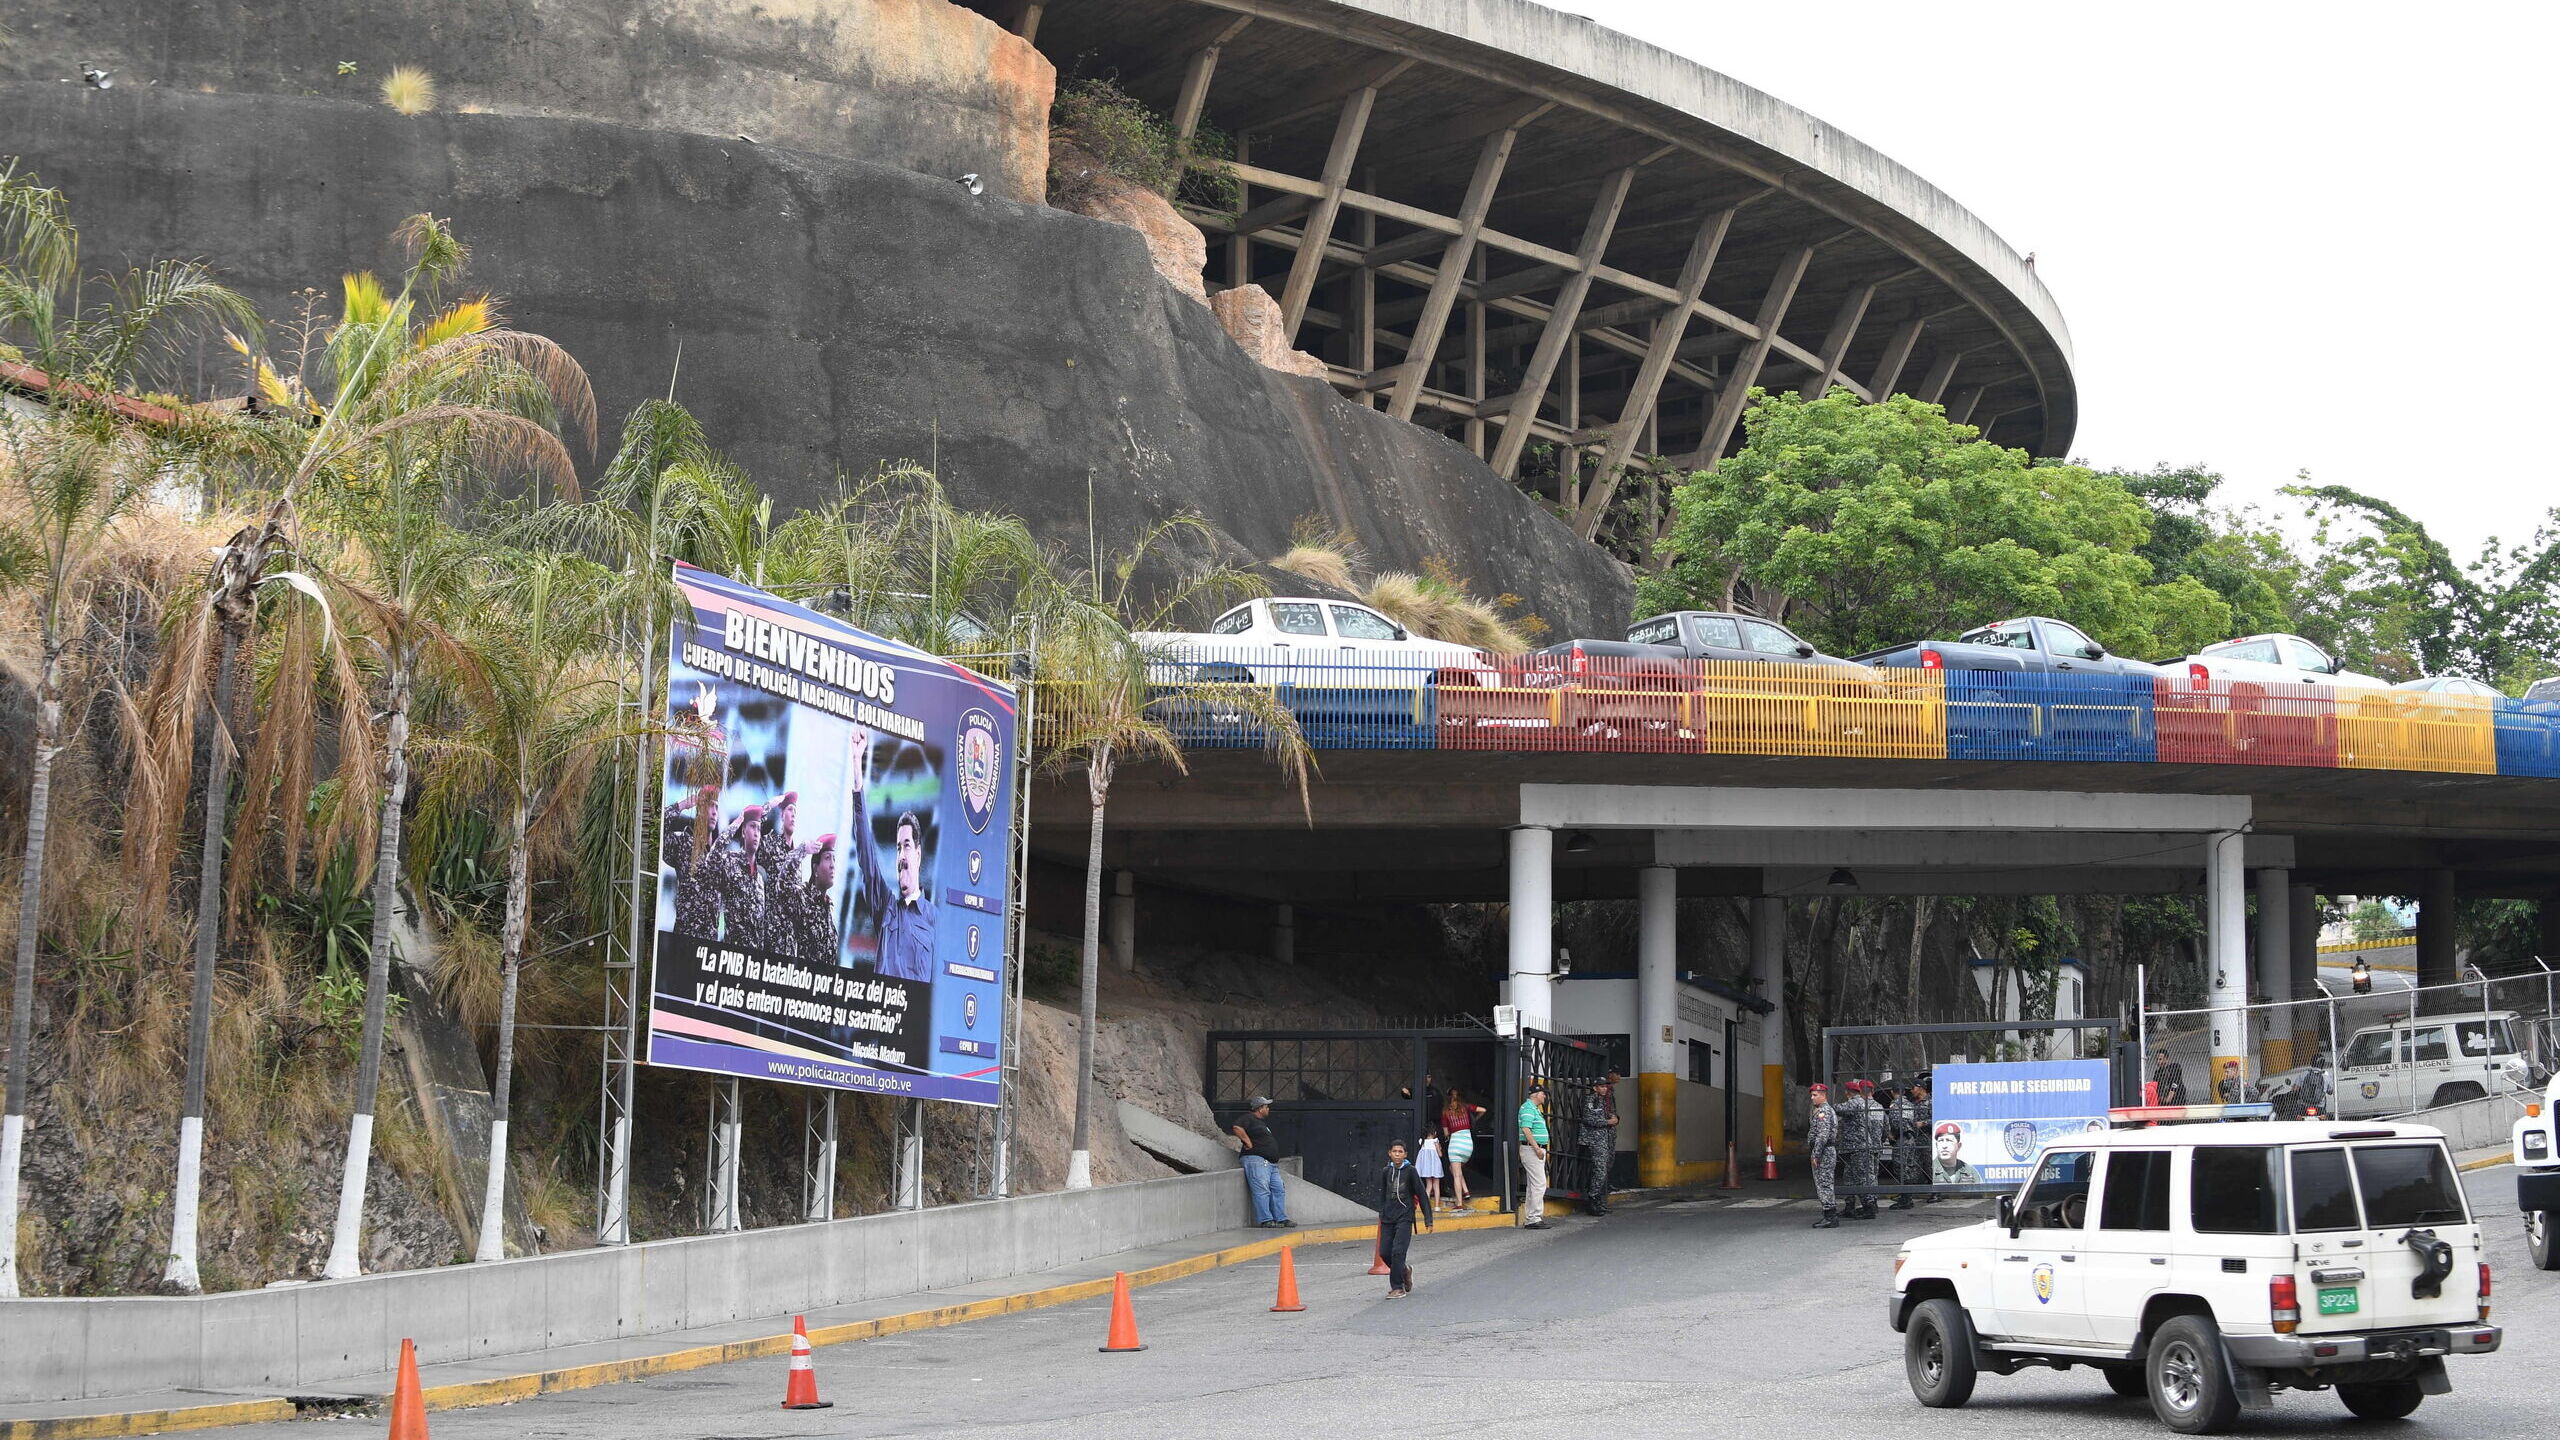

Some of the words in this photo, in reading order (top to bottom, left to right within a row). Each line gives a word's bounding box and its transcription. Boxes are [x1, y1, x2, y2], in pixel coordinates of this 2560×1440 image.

[1281, 613, 1317, 627] V-13
[724, 607, 895, 704] BIENVENIDOS
[682, 641, 733, 678] CUERPO
[734, 658, 751, 684] DE
[752, 664, 800, 701] POLICÍA
[800, 681, 856, 719] NACIONAL
[857, 701, 925, 741] BOLIVARIANA
[968, 715, 992, 733] POLICIA
[958, 734, 968, 802] NACIONAL
[984, 743, 1001, 813] BOLIVARIANA
[718, 950, 744, 977] PNB
[745, 955, 760, 980] ha
[762, 959, 812, 990] batallado
[812, 973, 833, 996] por
[833, 973, 844, 996] la
[844, 980, 865, 1002] paz
[866, 980, 884, 1002] del
[883, 984, 908, 1011] país,
[694, 982, 705, 1006] y
[705, 980, 718, 1003] el
[718, 983, 745, 1010] país
[746, 989, 782, 1015] entero
[783, 998, 832, 1024] reconoce
[833, 1007, 847, 1026] su
[852, 1041, 879, 1060] Nicolás
[879, 1045, 906, 1064] Maduro
[768, 1061, 912, 1092] www.policianacional.gob.ve
[2350, 1063, 2399, 1074] PATRULLAJE
[2401, 1059, 2452, 1070] INTLIGENTE
[1950, 1081, 1978, 1095] PARE
[1979, 1080, 2009, 1094] ZONA
[2010, 1080, 2025, 1093] DE
[2026, 1078, 2091, 1093] SEGURIDAD
[1984, 1166, 2061, 1180] IDENTIFIESE
[2320, 1293, 2356, 1308] 3P224
